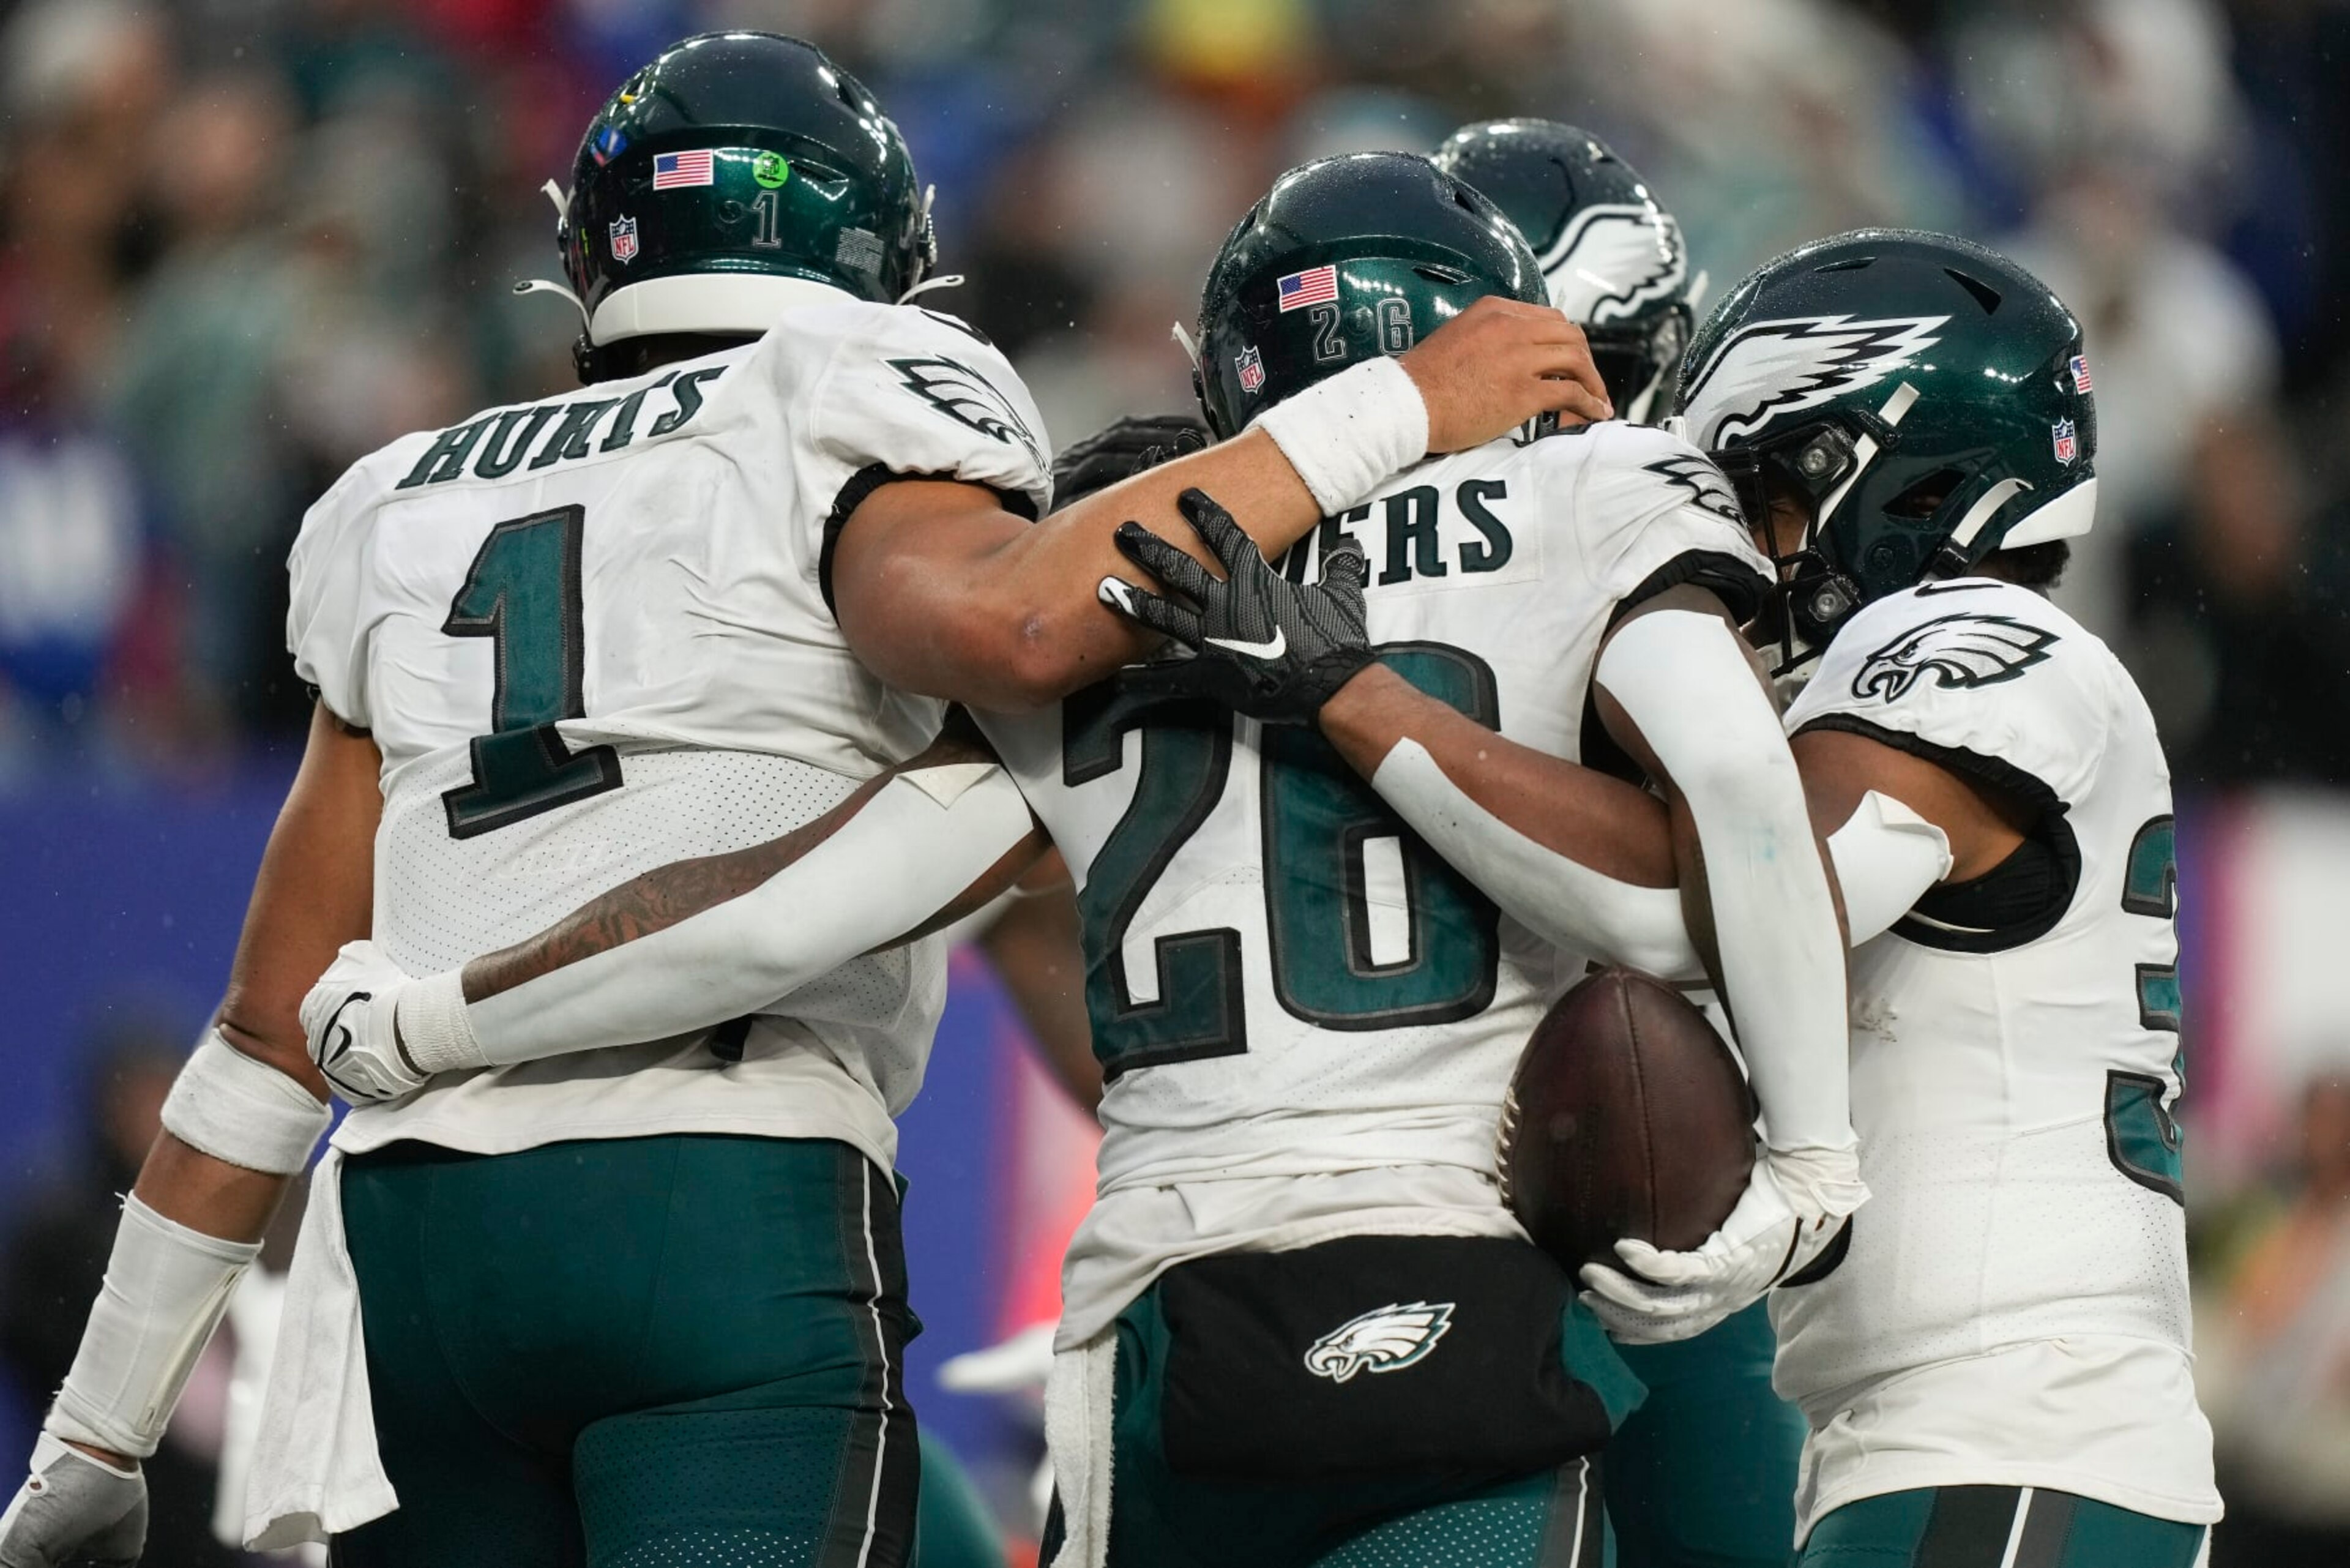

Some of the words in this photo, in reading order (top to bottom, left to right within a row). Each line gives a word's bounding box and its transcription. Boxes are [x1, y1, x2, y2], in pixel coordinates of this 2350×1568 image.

[614, 235, 635, 256] NFL
[751, 190, 781, 249] 1
[1240, 365, 1263, 387] NFL
[395, 365, 730, 490] HURTS
[2057, 438, 2074, 458] NFL
[440, 503, 624, 840] 1
[1062, 640, 1502, 1086] 26
